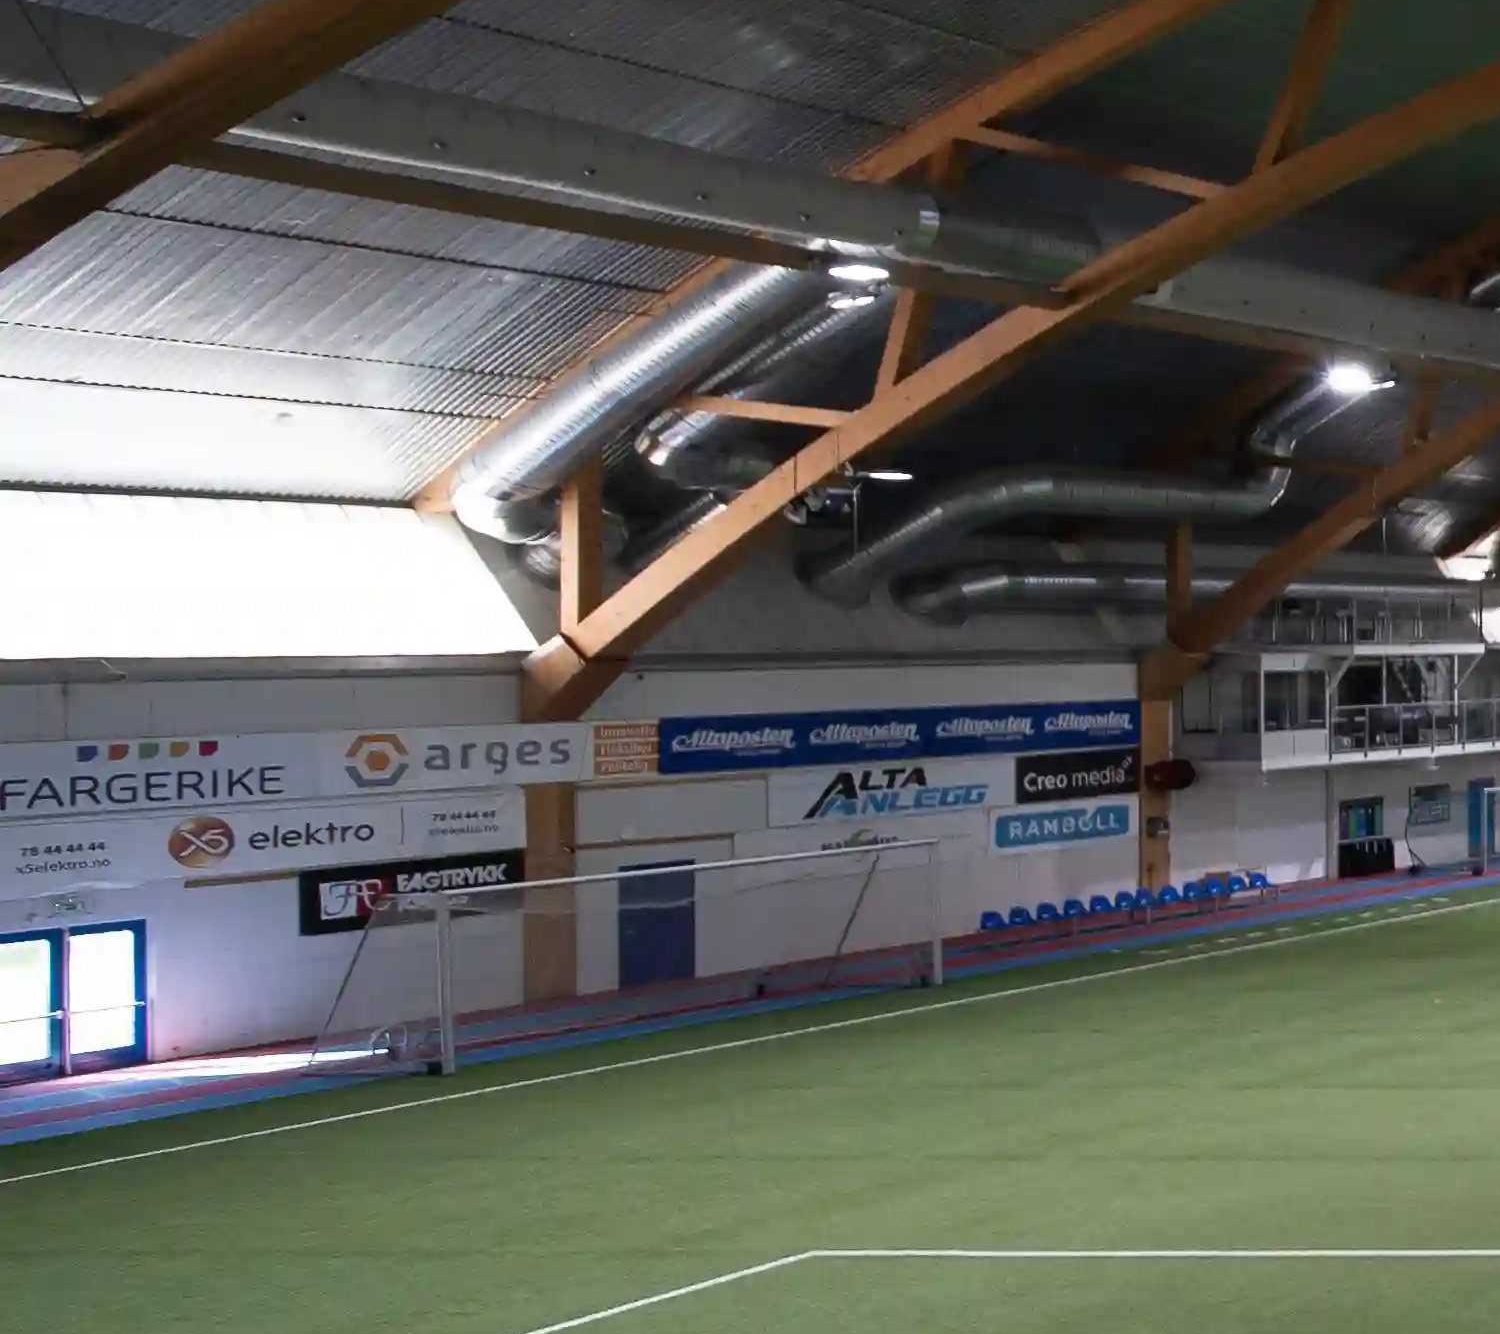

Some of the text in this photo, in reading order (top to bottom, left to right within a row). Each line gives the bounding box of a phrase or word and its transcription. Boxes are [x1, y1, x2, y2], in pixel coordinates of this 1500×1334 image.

[672, 727, 797, 753] Altaposten
[809, 721, 920, 745] Altaposten
[424, 738, 571, 775] arges
[0, 765, 286, 811] FARGERIKE
[803, 767, 928, 820] ALTA
[1023, 771, 1067, 792] Creo
[1072, 765, 1126, 788] media
[818, 784, 989, 818] ANLEGG
[248, 818, 375, 851] elektro
[396, 863, 508, 893] FAGTRYKK
